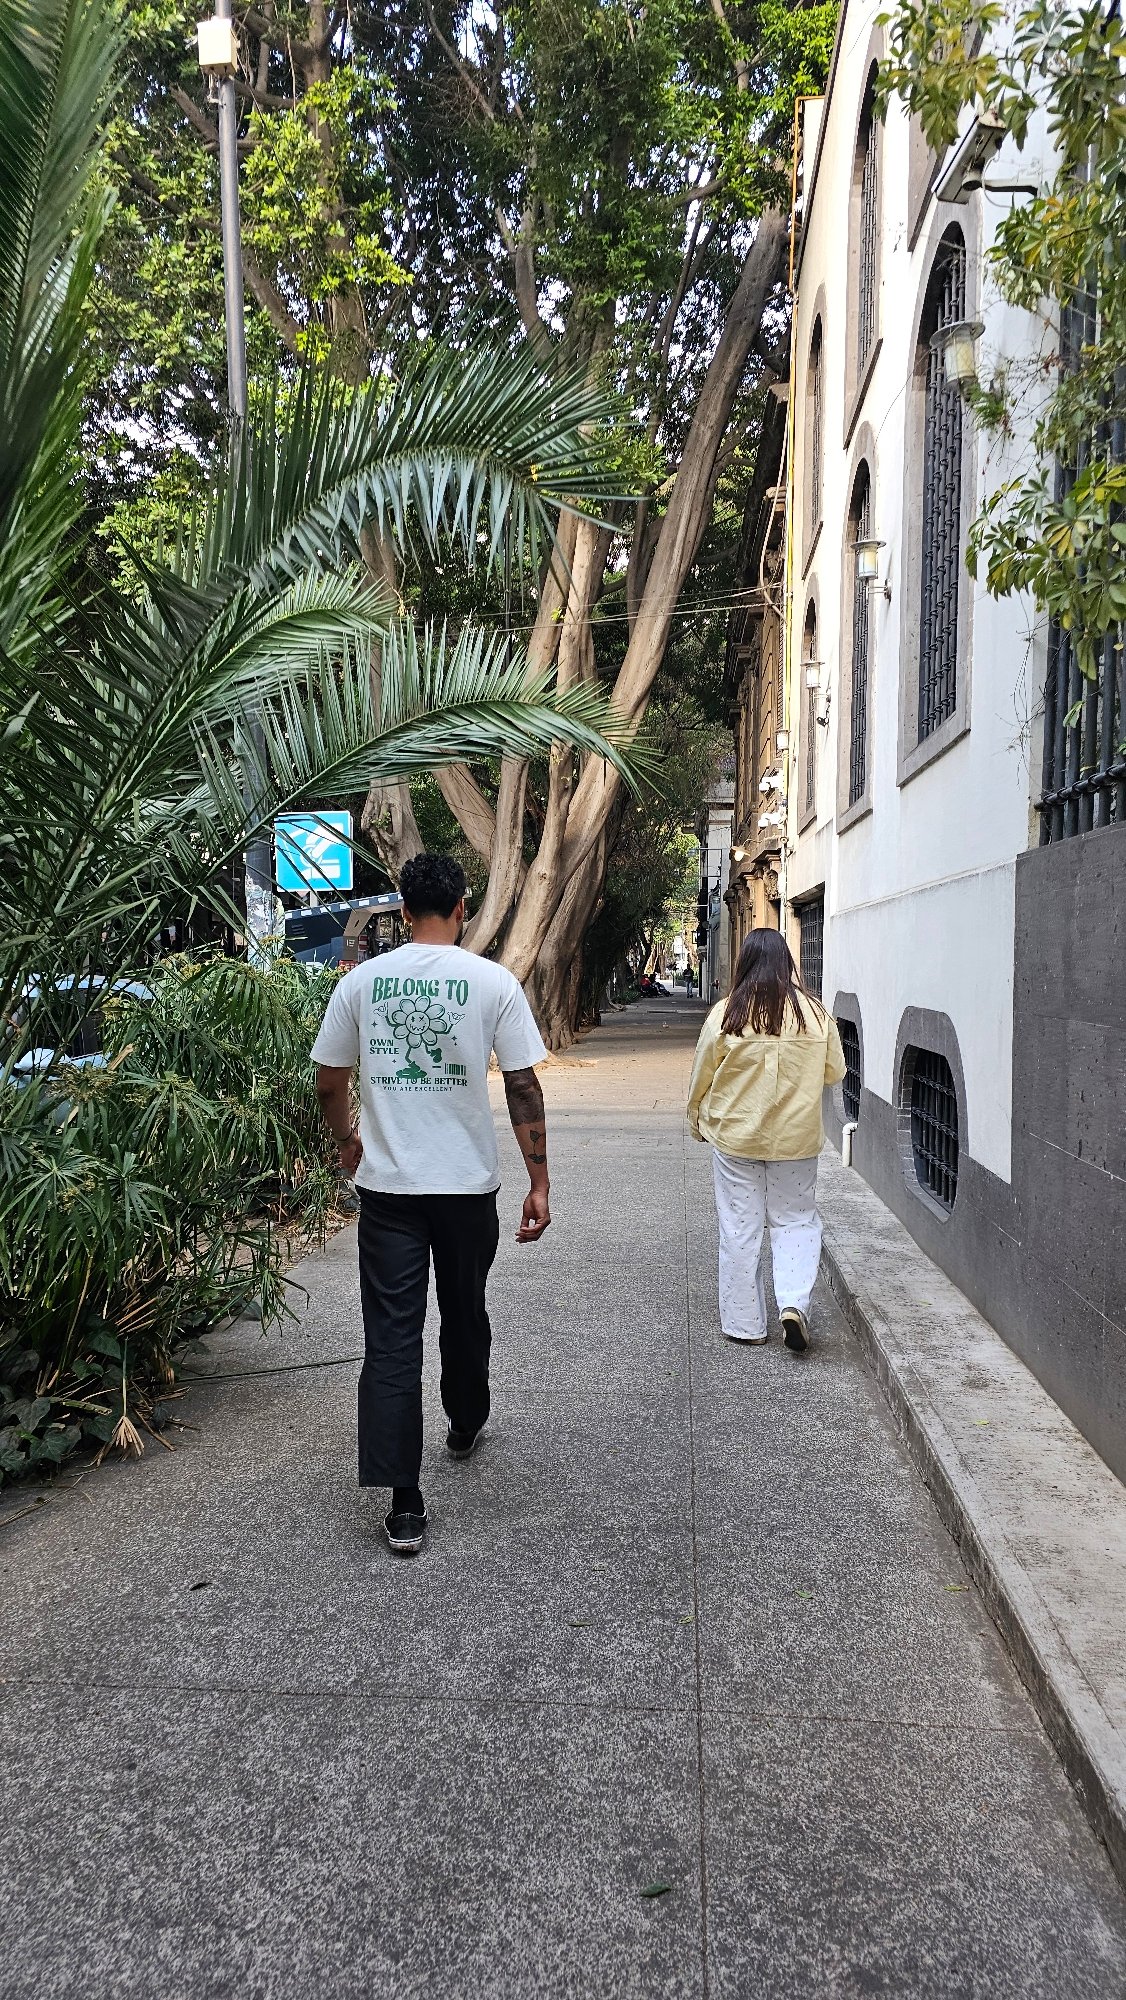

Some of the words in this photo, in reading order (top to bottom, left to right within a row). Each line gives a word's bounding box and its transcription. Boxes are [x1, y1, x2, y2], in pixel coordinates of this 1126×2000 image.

[371, 976, 439, 1004] BELONG
[445, 979, 469, 1006] TO
[370, 1038, 394, 1047] OWN
[369, 1047, 399, 1055] STYLE
[370, 1076, 402, 1085] STRIVE
[420, 1077, 432, 1085] BE
[434, 1077, 468, 1087] BETTER
